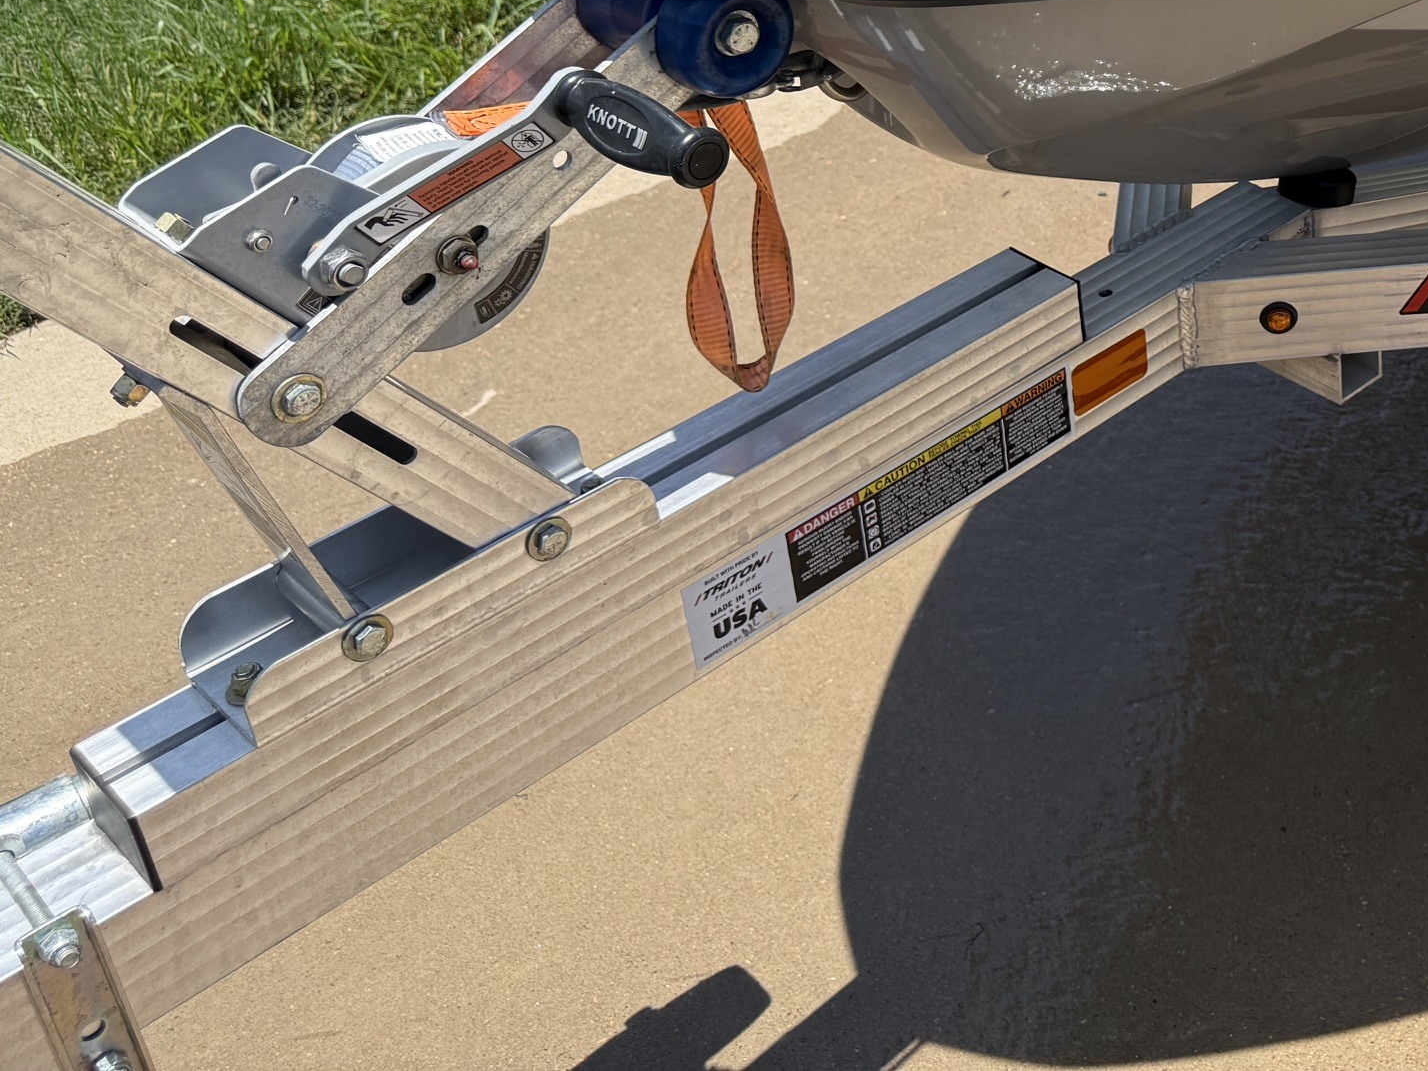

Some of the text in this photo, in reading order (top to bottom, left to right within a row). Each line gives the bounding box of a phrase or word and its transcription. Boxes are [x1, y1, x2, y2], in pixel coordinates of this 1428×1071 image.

[587, 104, 637, 138] KNOTT
[1014, 373, 1063, 408] WARNING
[875, 455, 926, 491] CAUTION
[803, 497, 855, 532] DANGER
[751, 549, 758, 558] BY
[703, 555, 766, 601] TRITON
[709, 581, 762, 618] MADE IN THE
[713, 598, 768, 639] USA
